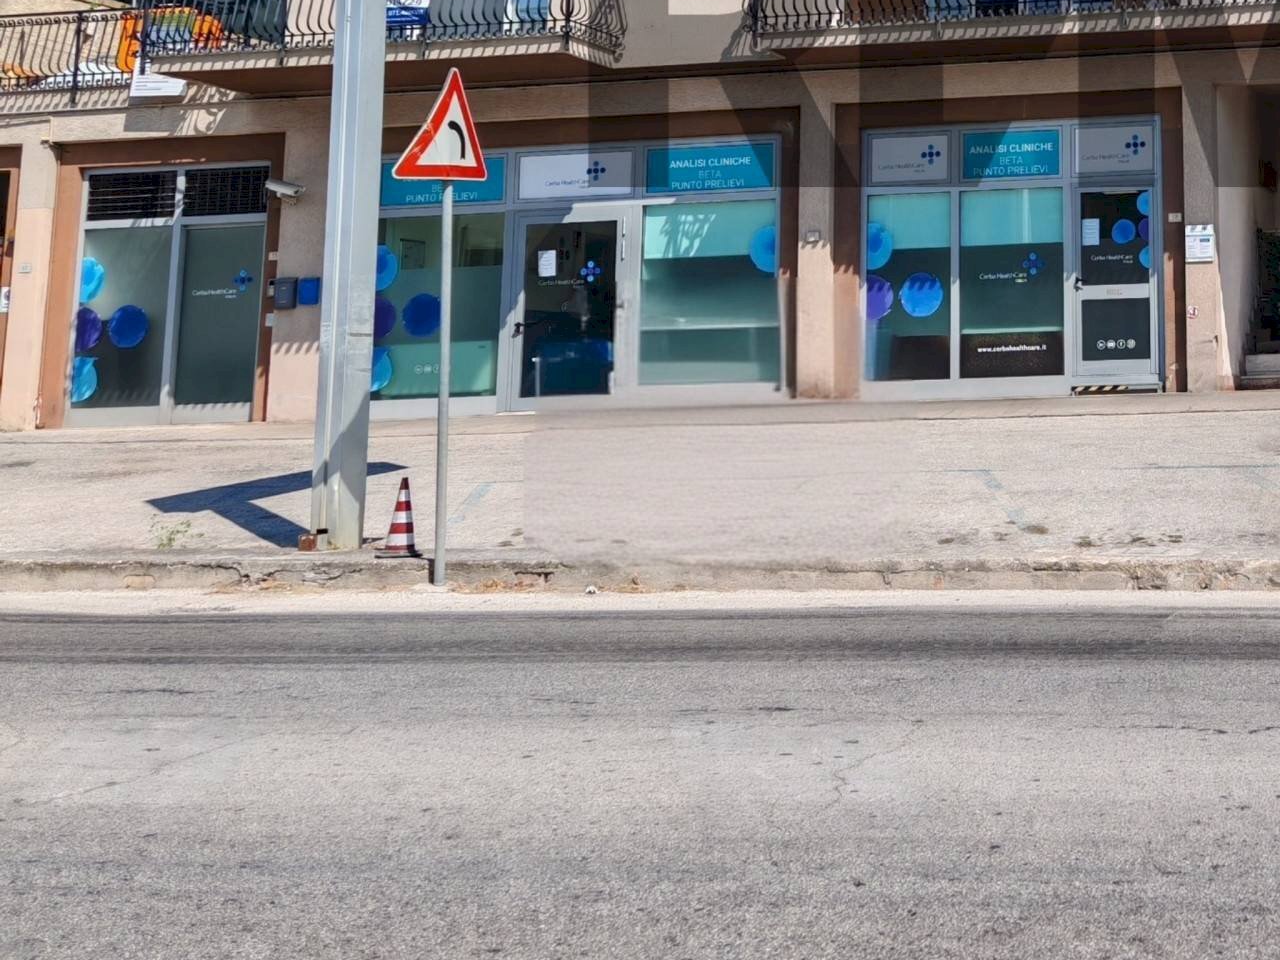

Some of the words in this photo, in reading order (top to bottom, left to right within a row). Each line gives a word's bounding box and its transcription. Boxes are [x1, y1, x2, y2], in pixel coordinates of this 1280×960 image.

[969, 144, 1007, 155] ANALISI
[1009, 142, 1053, 153] CLINICHE
[669, 159, 706, 168] ANALISI
[708, 157, 752, 166] CLINICHE
[999, 156, 1023, 165] BETA
[698, 170, 722, 179] BETA
[973, 167, 1006, 176] PUNTO
[1007, 165, 1048, 175] PRELIEVI
[671, 181, 702, 190] PUNTO
[704, 179, 745, 189] PRELIEVI
[406, 194, 437, 202] PUNTO
